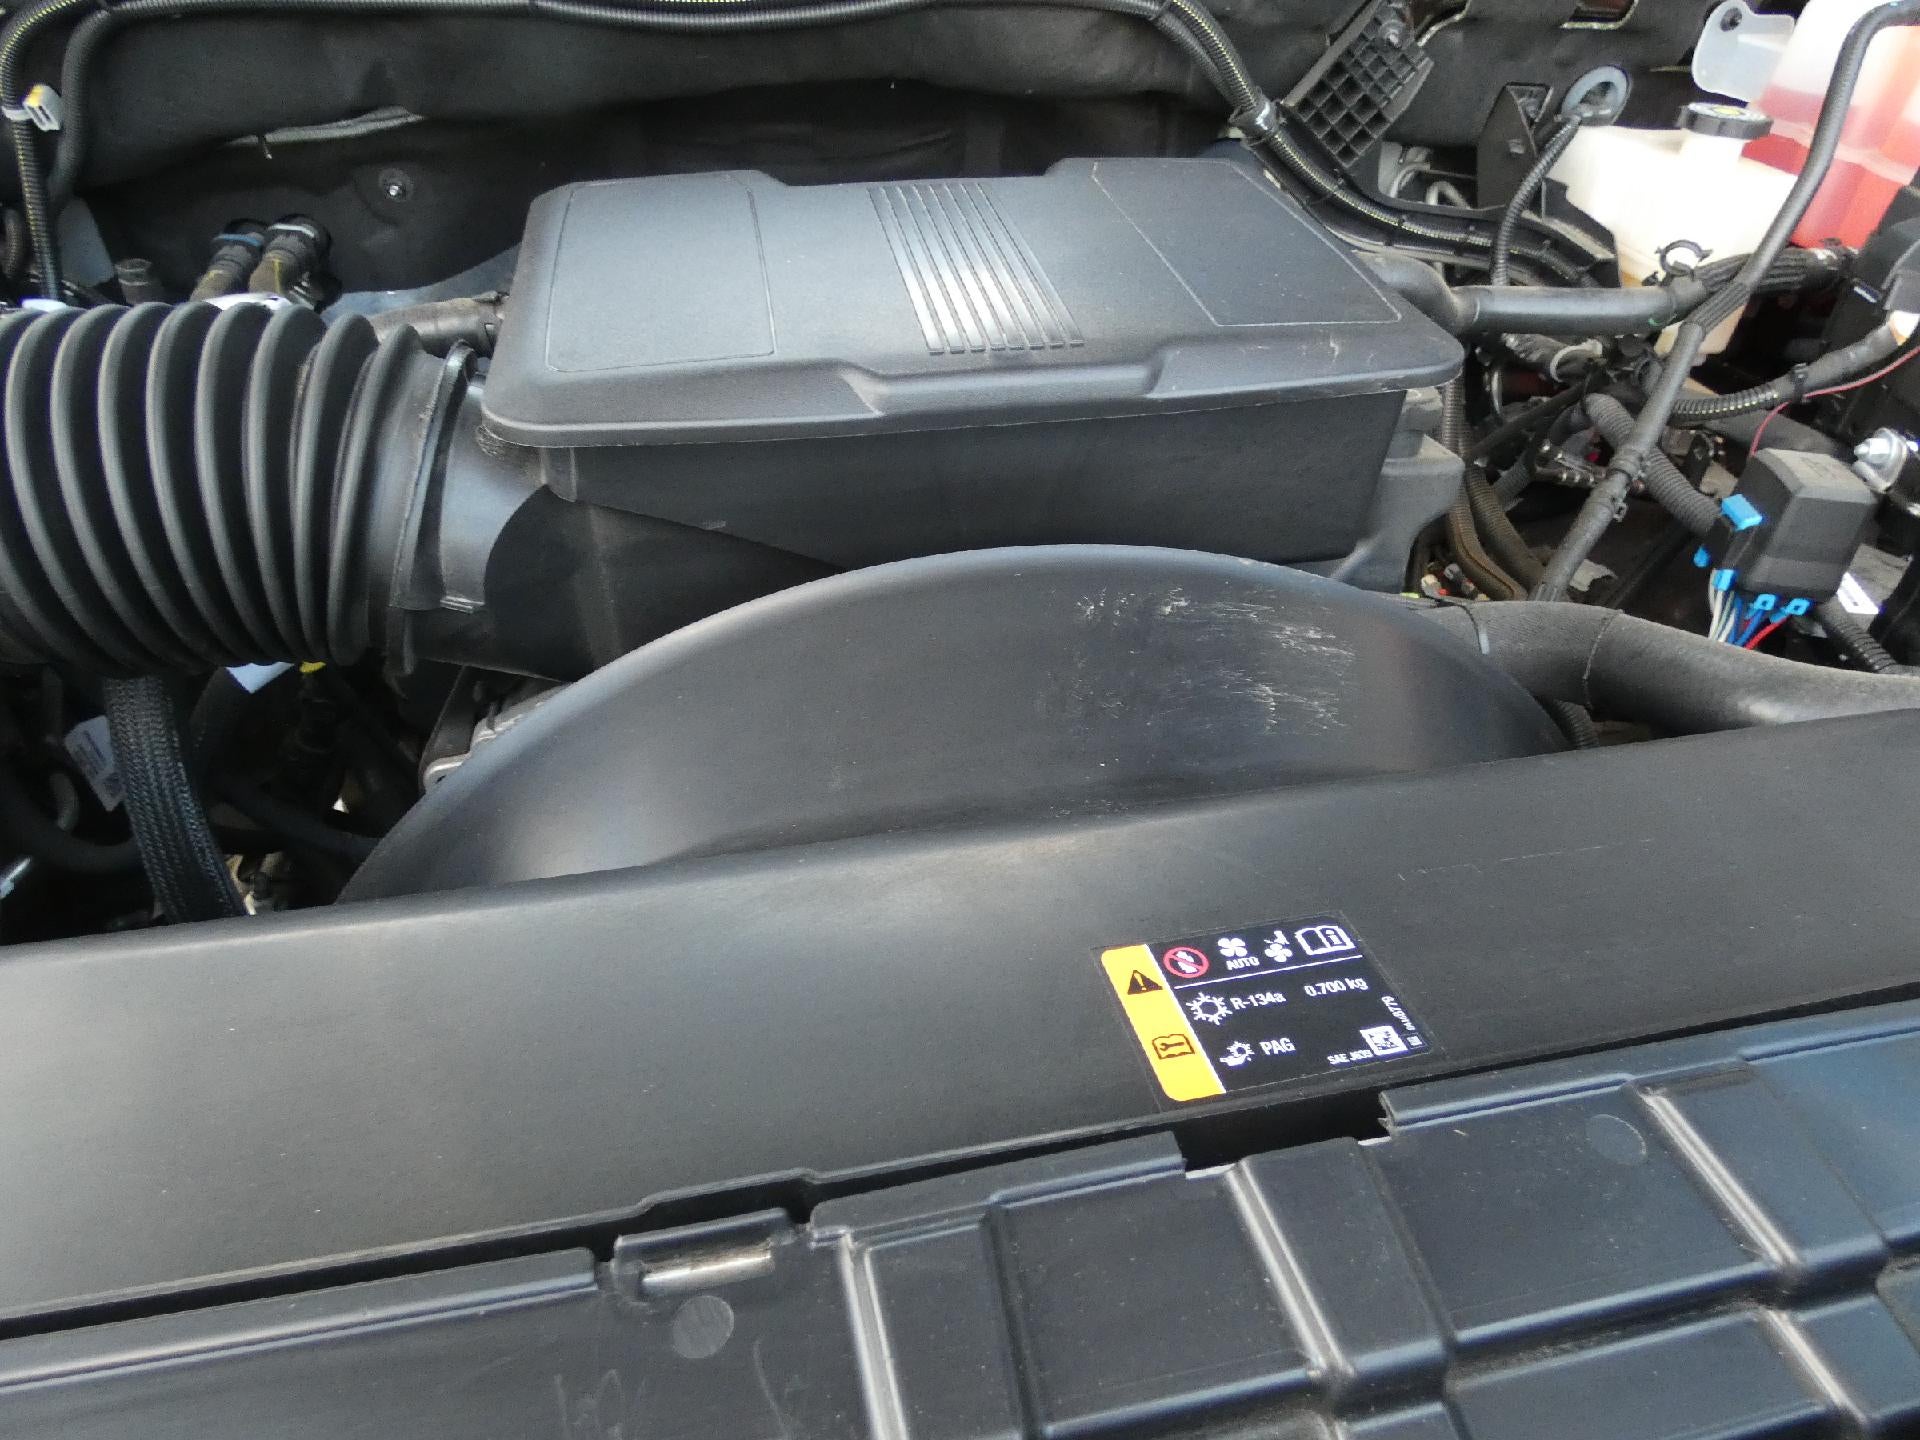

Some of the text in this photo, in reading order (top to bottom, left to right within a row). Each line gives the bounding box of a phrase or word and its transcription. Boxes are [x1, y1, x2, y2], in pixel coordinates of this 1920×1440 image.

[1226, 956, 1260, 970] AUTO
[1303, 977, 1369, 997] 0.700 kg
[1230, 992, 1287, 1010] R-134a
[1259, 1037, 1296, 1055] PAG
[1327, 1053, 1350, 1065] SAE
